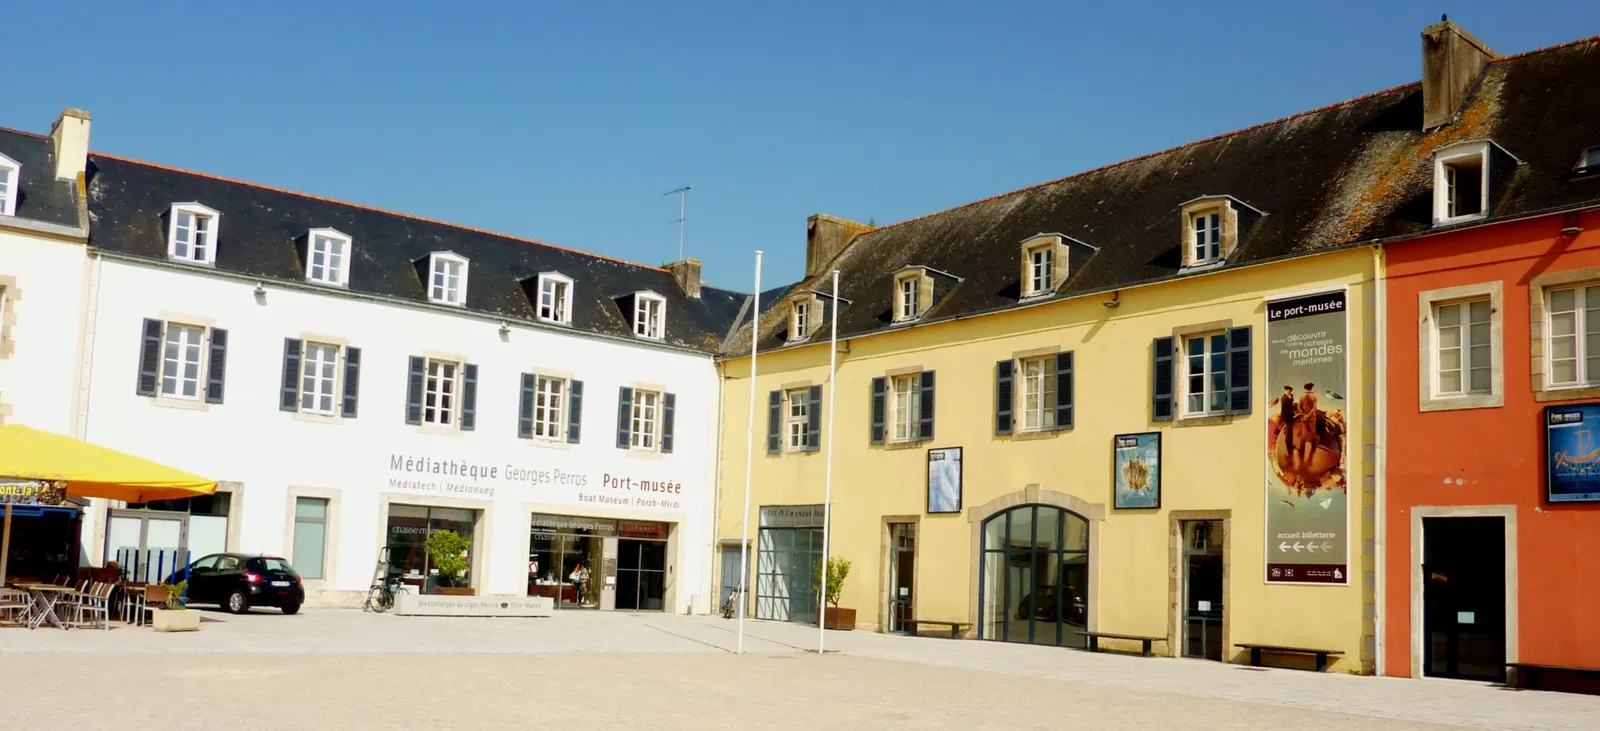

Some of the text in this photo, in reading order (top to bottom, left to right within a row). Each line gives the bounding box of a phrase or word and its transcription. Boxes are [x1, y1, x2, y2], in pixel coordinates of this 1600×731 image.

[1270, 300, 1343, 319] Le port-musée
[1286, 330, 1327, 342] découvrir
[1289, 344, 1343, 359] mondes
[1292, 355, 1333, 366] maritimes
[390, 454, 587, 486] Médiathèque Georges Perros
[389, 478, 436, 491] Mediatech
[579, 492, 596, 503] Boat
[599, 494, 629, 505] Museum
[568, 520, 594, 531] Georges
[594, 523, 614, 531] Perros
[1277, 531, 1336, 539] accueil billetterie
